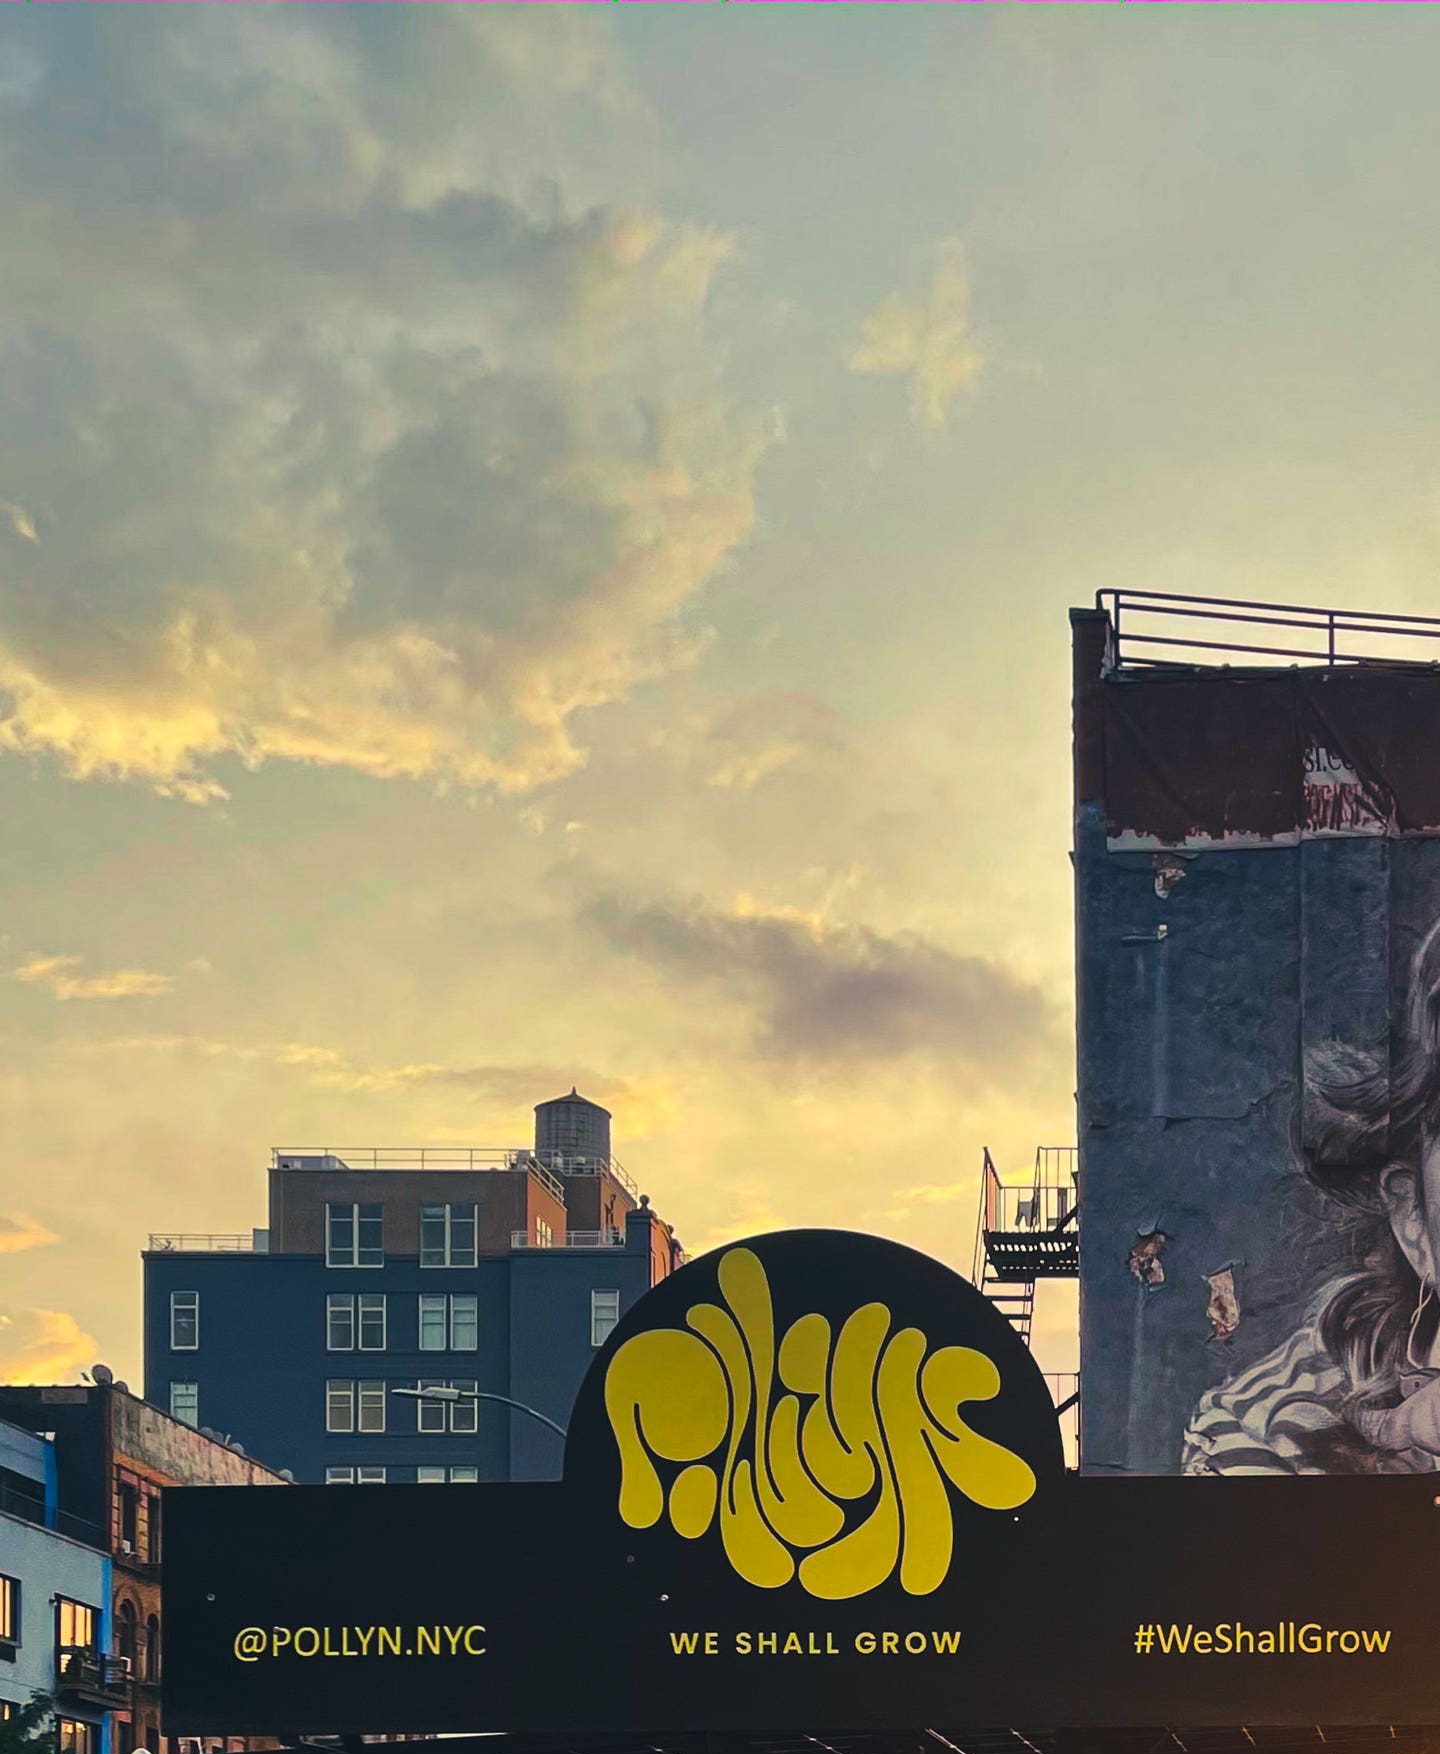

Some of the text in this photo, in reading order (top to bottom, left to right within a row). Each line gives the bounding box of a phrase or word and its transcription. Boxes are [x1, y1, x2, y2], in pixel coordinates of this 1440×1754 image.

[233, 1625, 487, 1662] @POLLYN.NYC
[669, 1631, 962, 1655] WE SHALL GROW
[1133, 1622, 1392, 1654] #WeShallGrow
